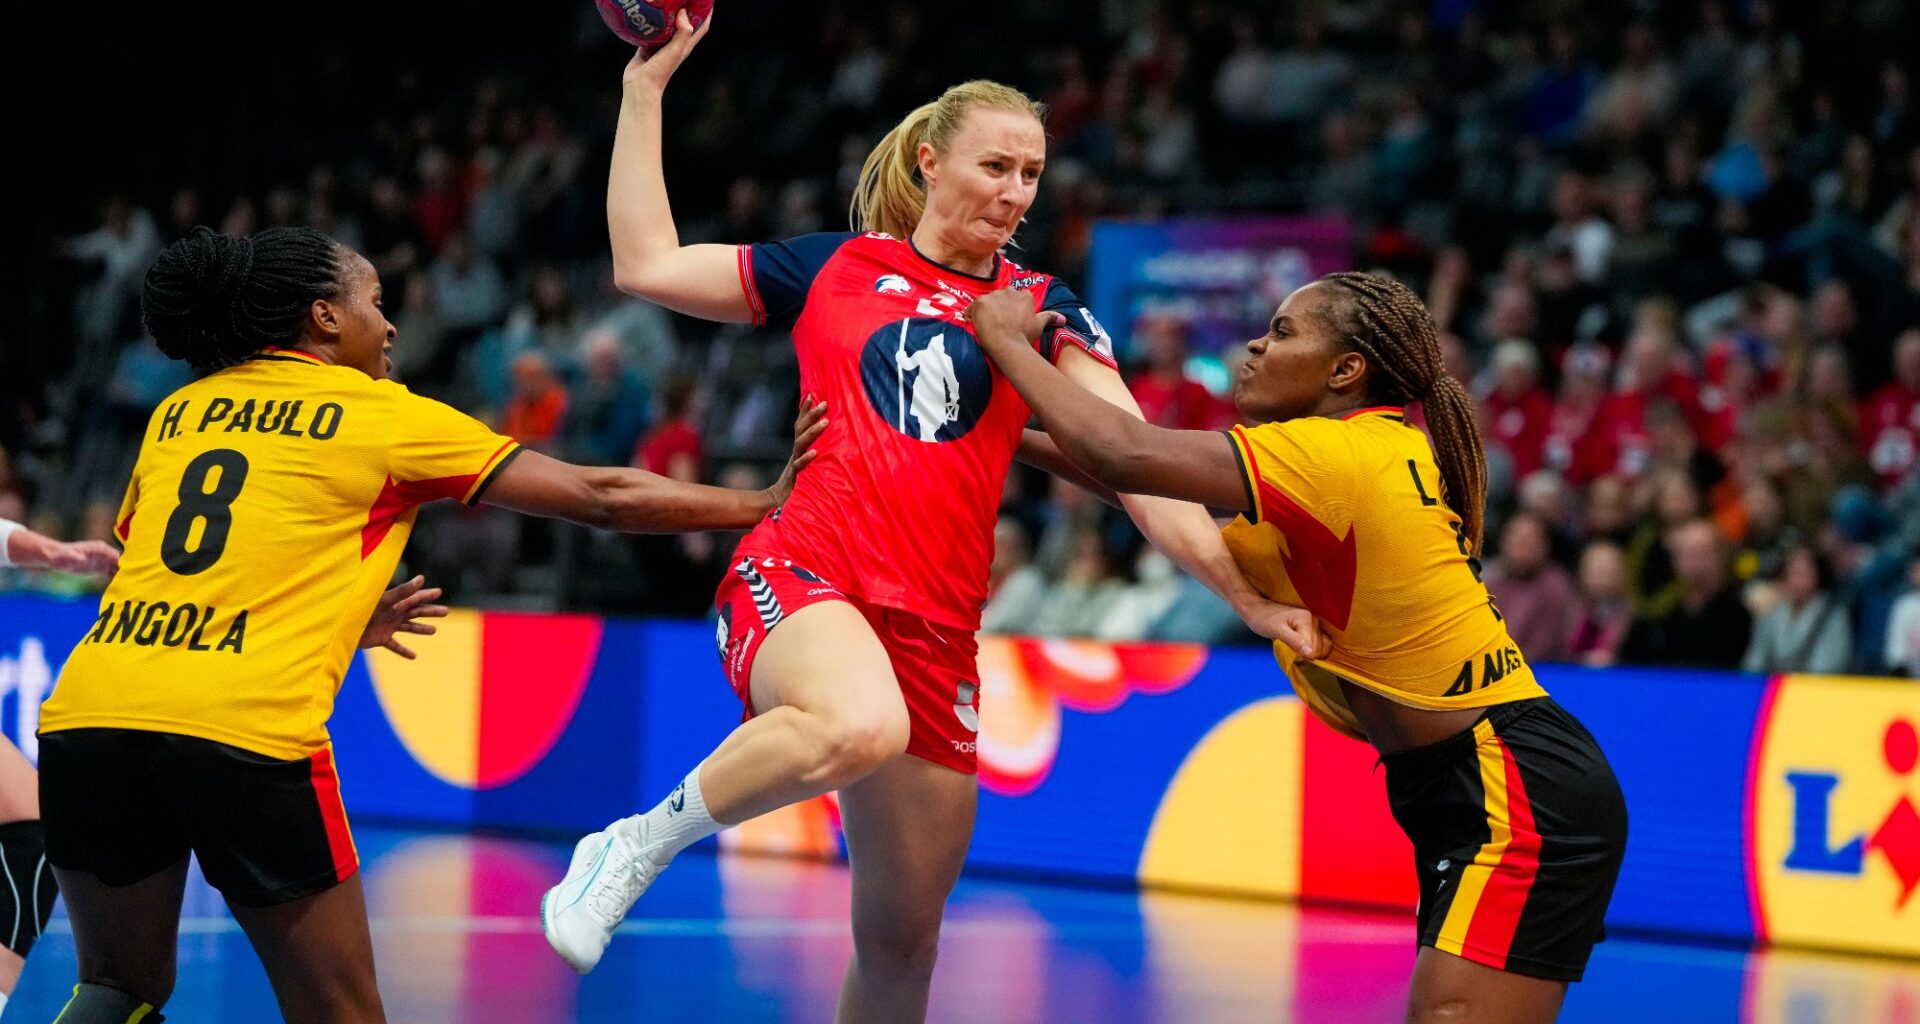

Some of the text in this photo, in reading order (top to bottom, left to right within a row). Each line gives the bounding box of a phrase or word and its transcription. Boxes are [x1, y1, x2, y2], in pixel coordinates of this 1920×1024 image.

[158, 398, 344, 442] H. PAULO
[160, 448, 249, 575] 8
[84, 600, 249, 654] ANGOLA
